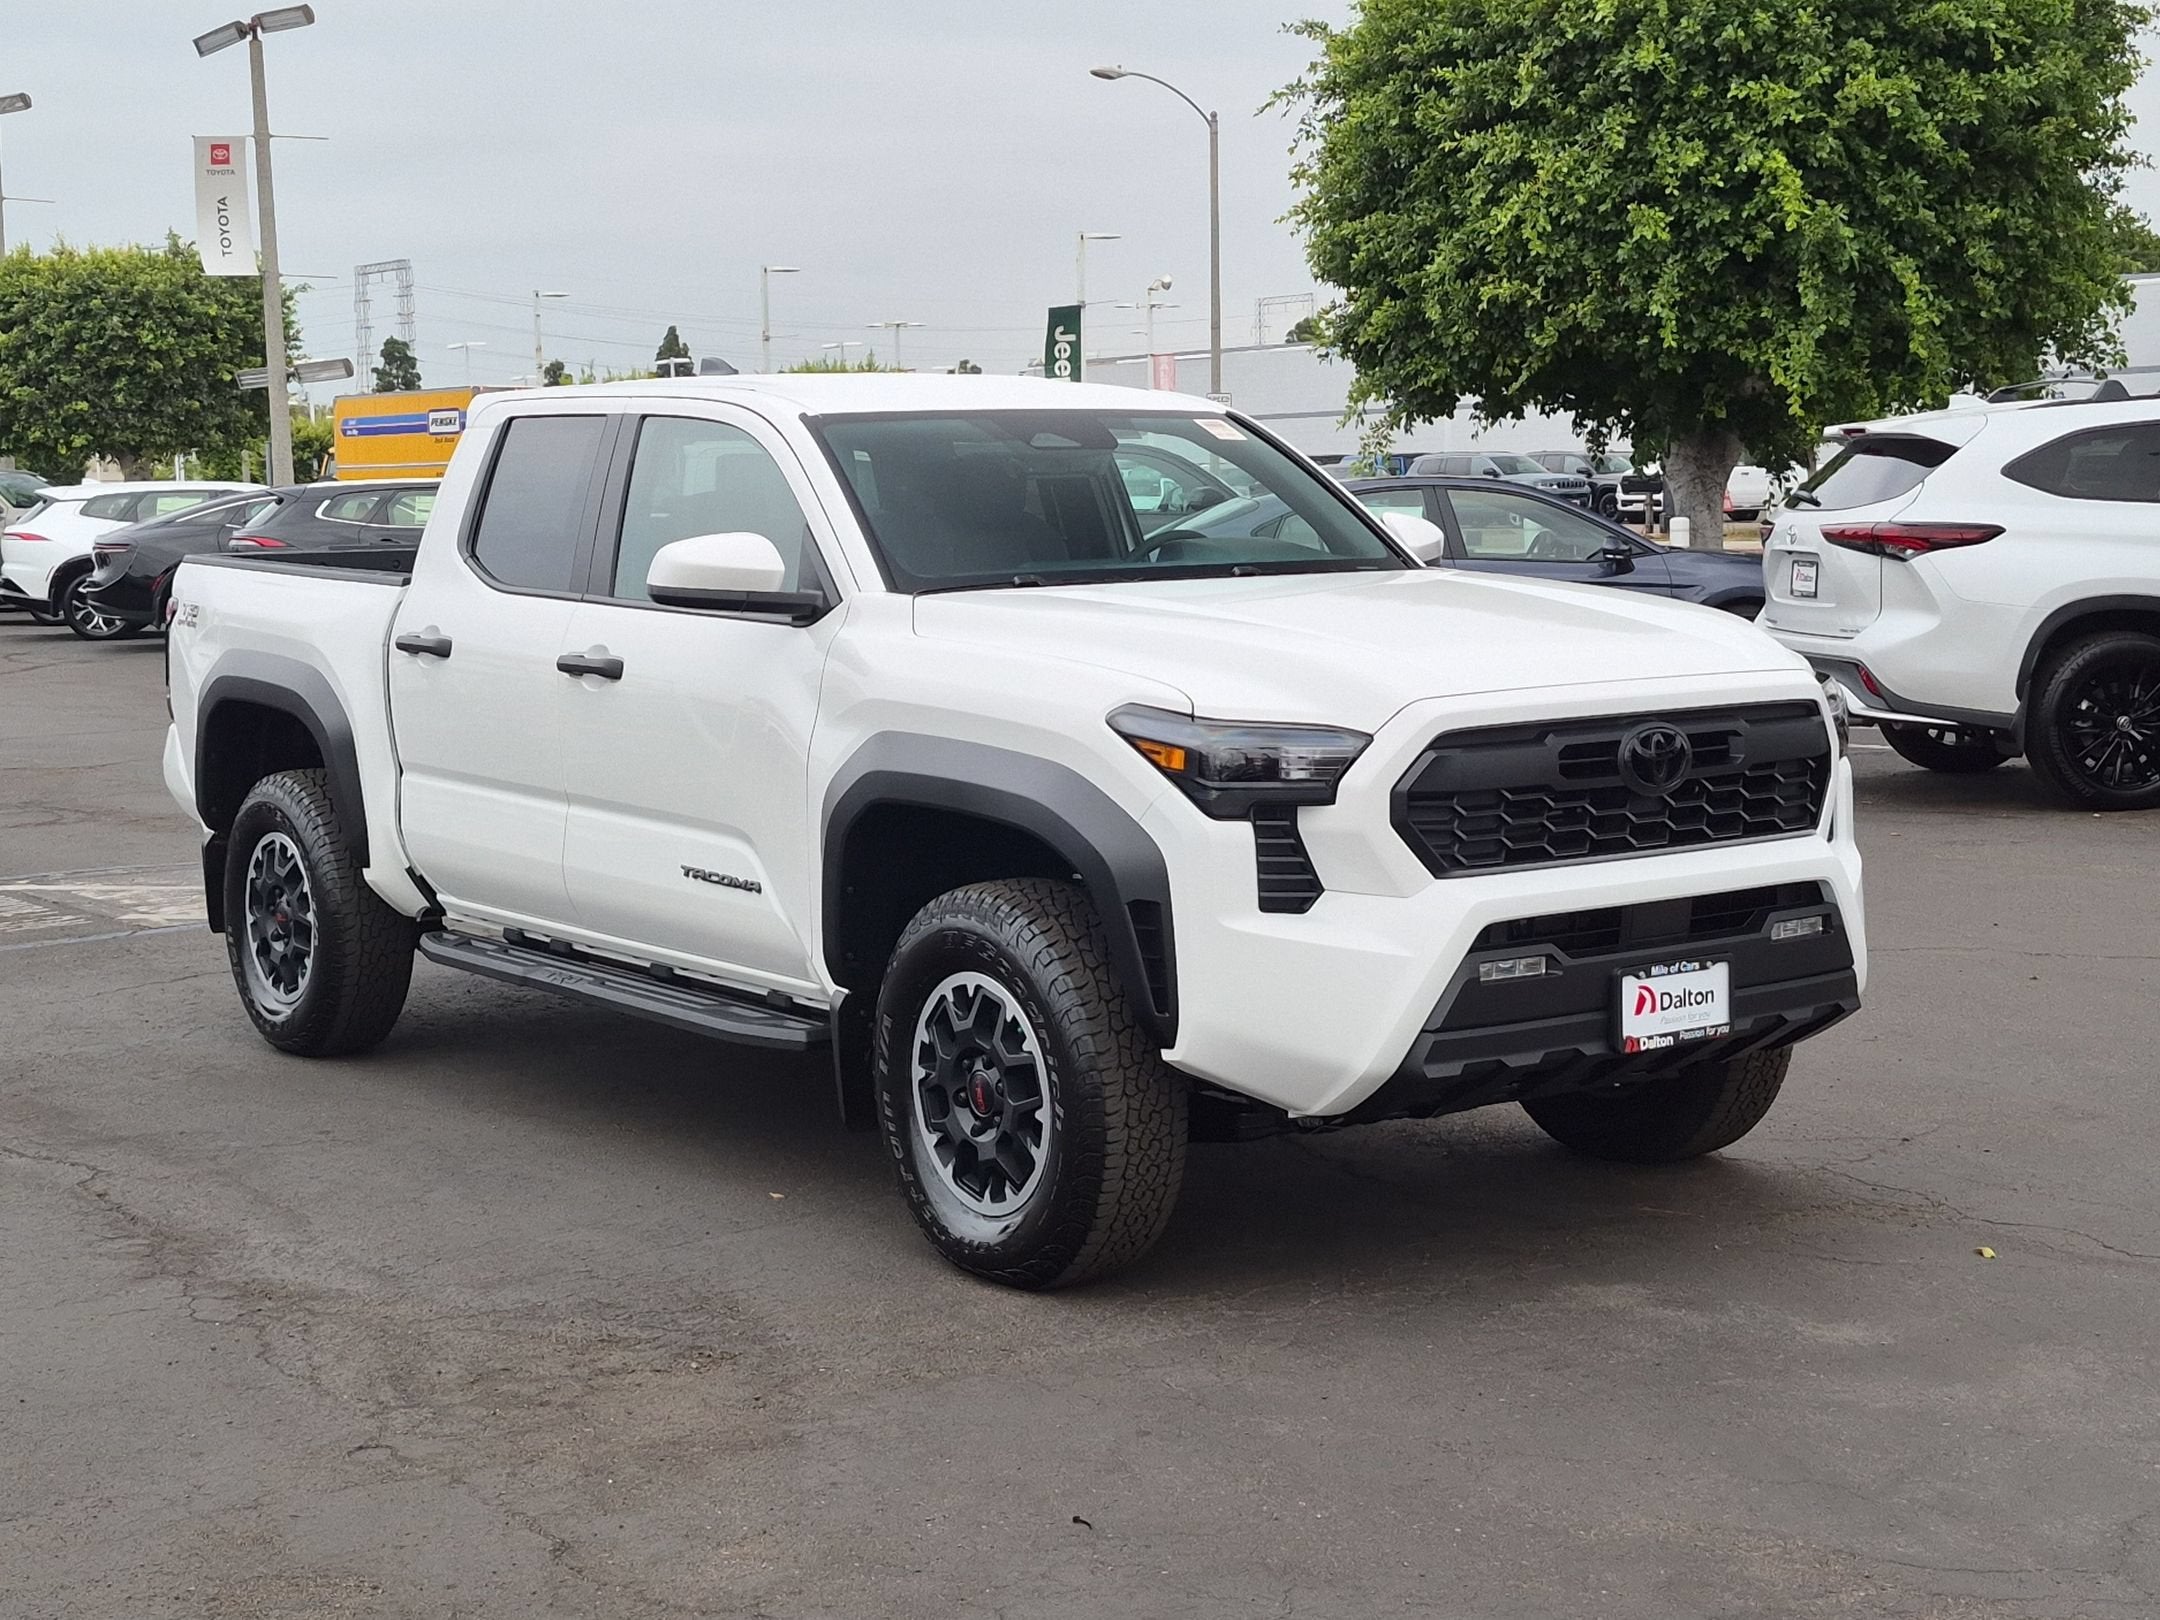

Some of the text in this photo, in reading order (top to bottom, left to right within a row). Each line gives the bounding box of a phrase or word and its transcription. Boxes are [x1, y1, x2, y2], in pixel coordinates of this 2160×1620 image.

[217, 196, 232, 257] TOYOTA
[1054, 325, 1077, 379] Jee
[680, 864, 762, 894] TACOMA
[1651, 961, 1700, 976] Mile of Cars
[1660, 987, 1714, 1011] Dalton
[1640, 1035, 1674, 1052] Dalton
